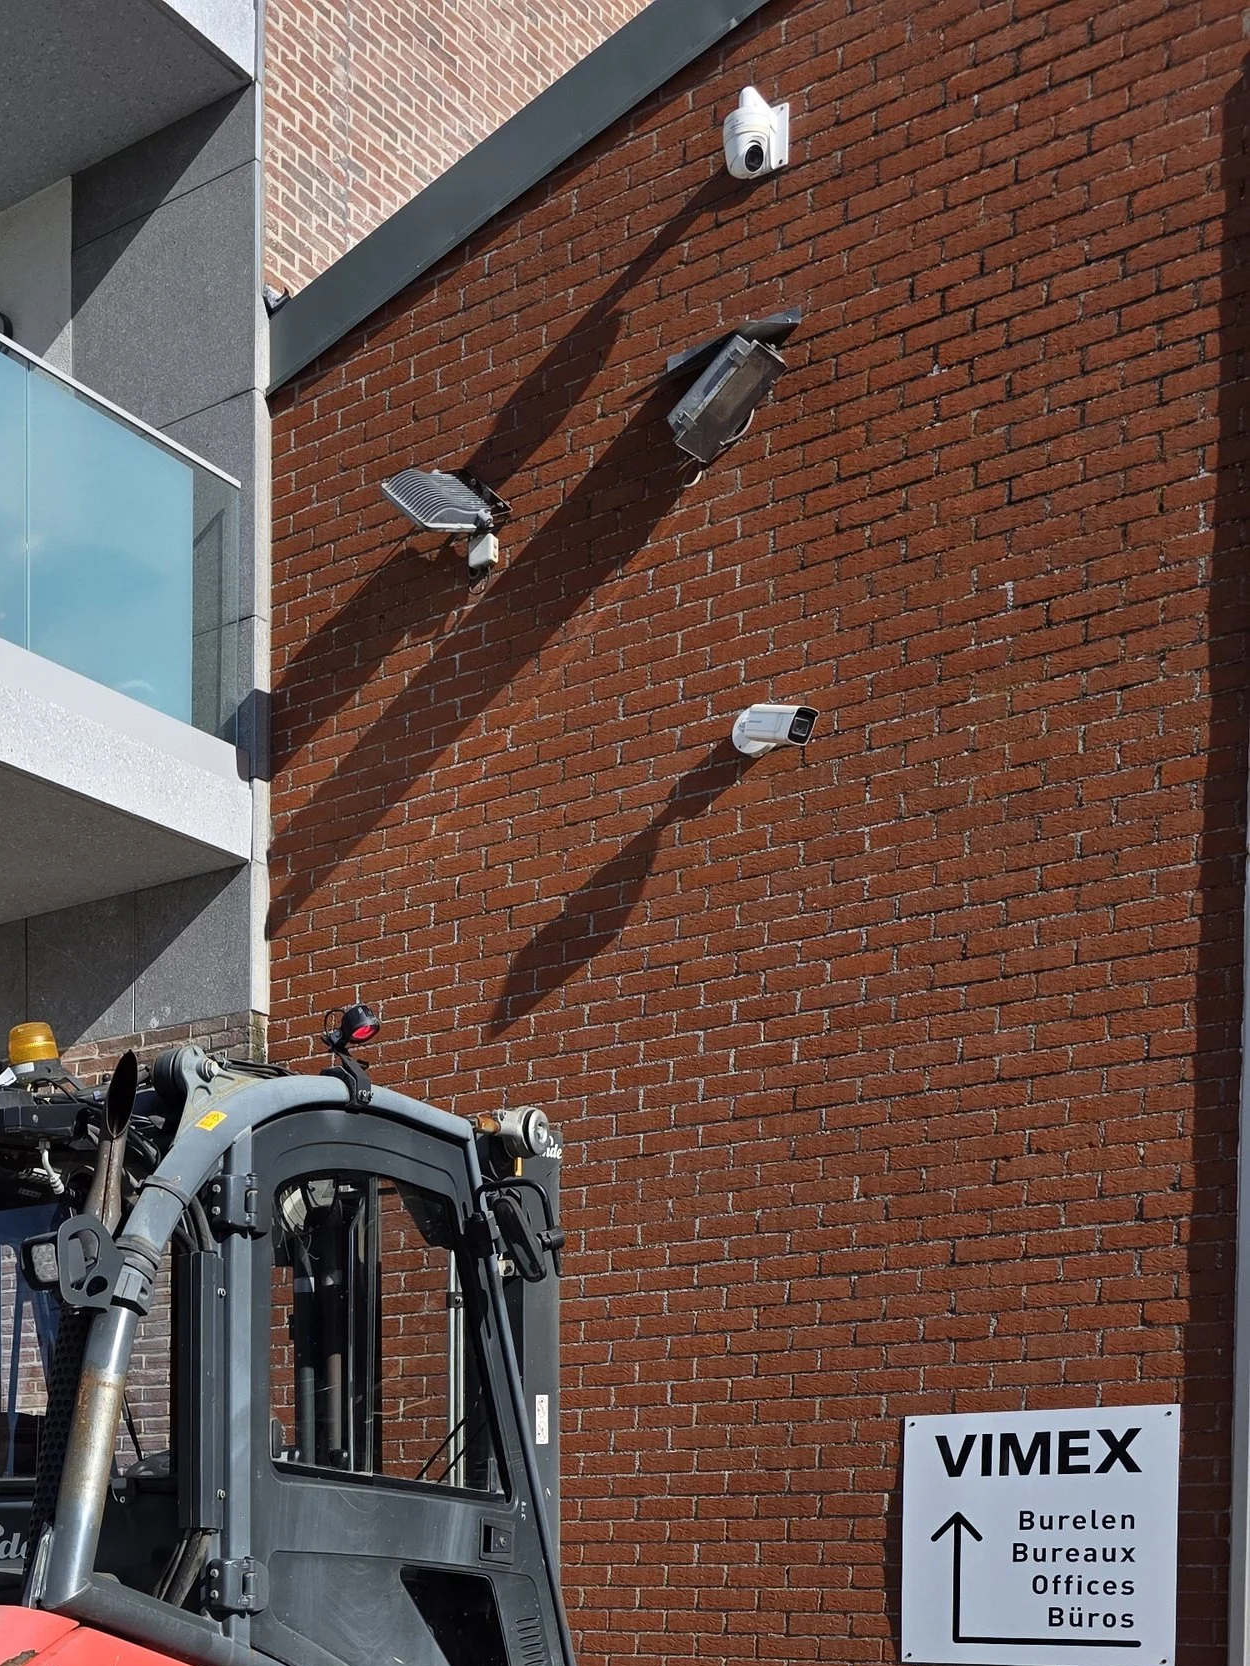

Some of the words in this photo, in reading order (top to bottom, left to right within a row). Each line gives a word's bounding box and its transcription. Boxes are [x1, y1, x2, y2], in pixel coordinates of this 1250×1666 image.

[935, 1427, 1142, 1478] VIMEX
[1019, 1509, 1136, 1531] Burelen
[1012, 1542, 1136, 1563] Bureaux
[1031, 1574, 1135, 1595] Offices
[1047, 1606, 1135, 1629] Büros
